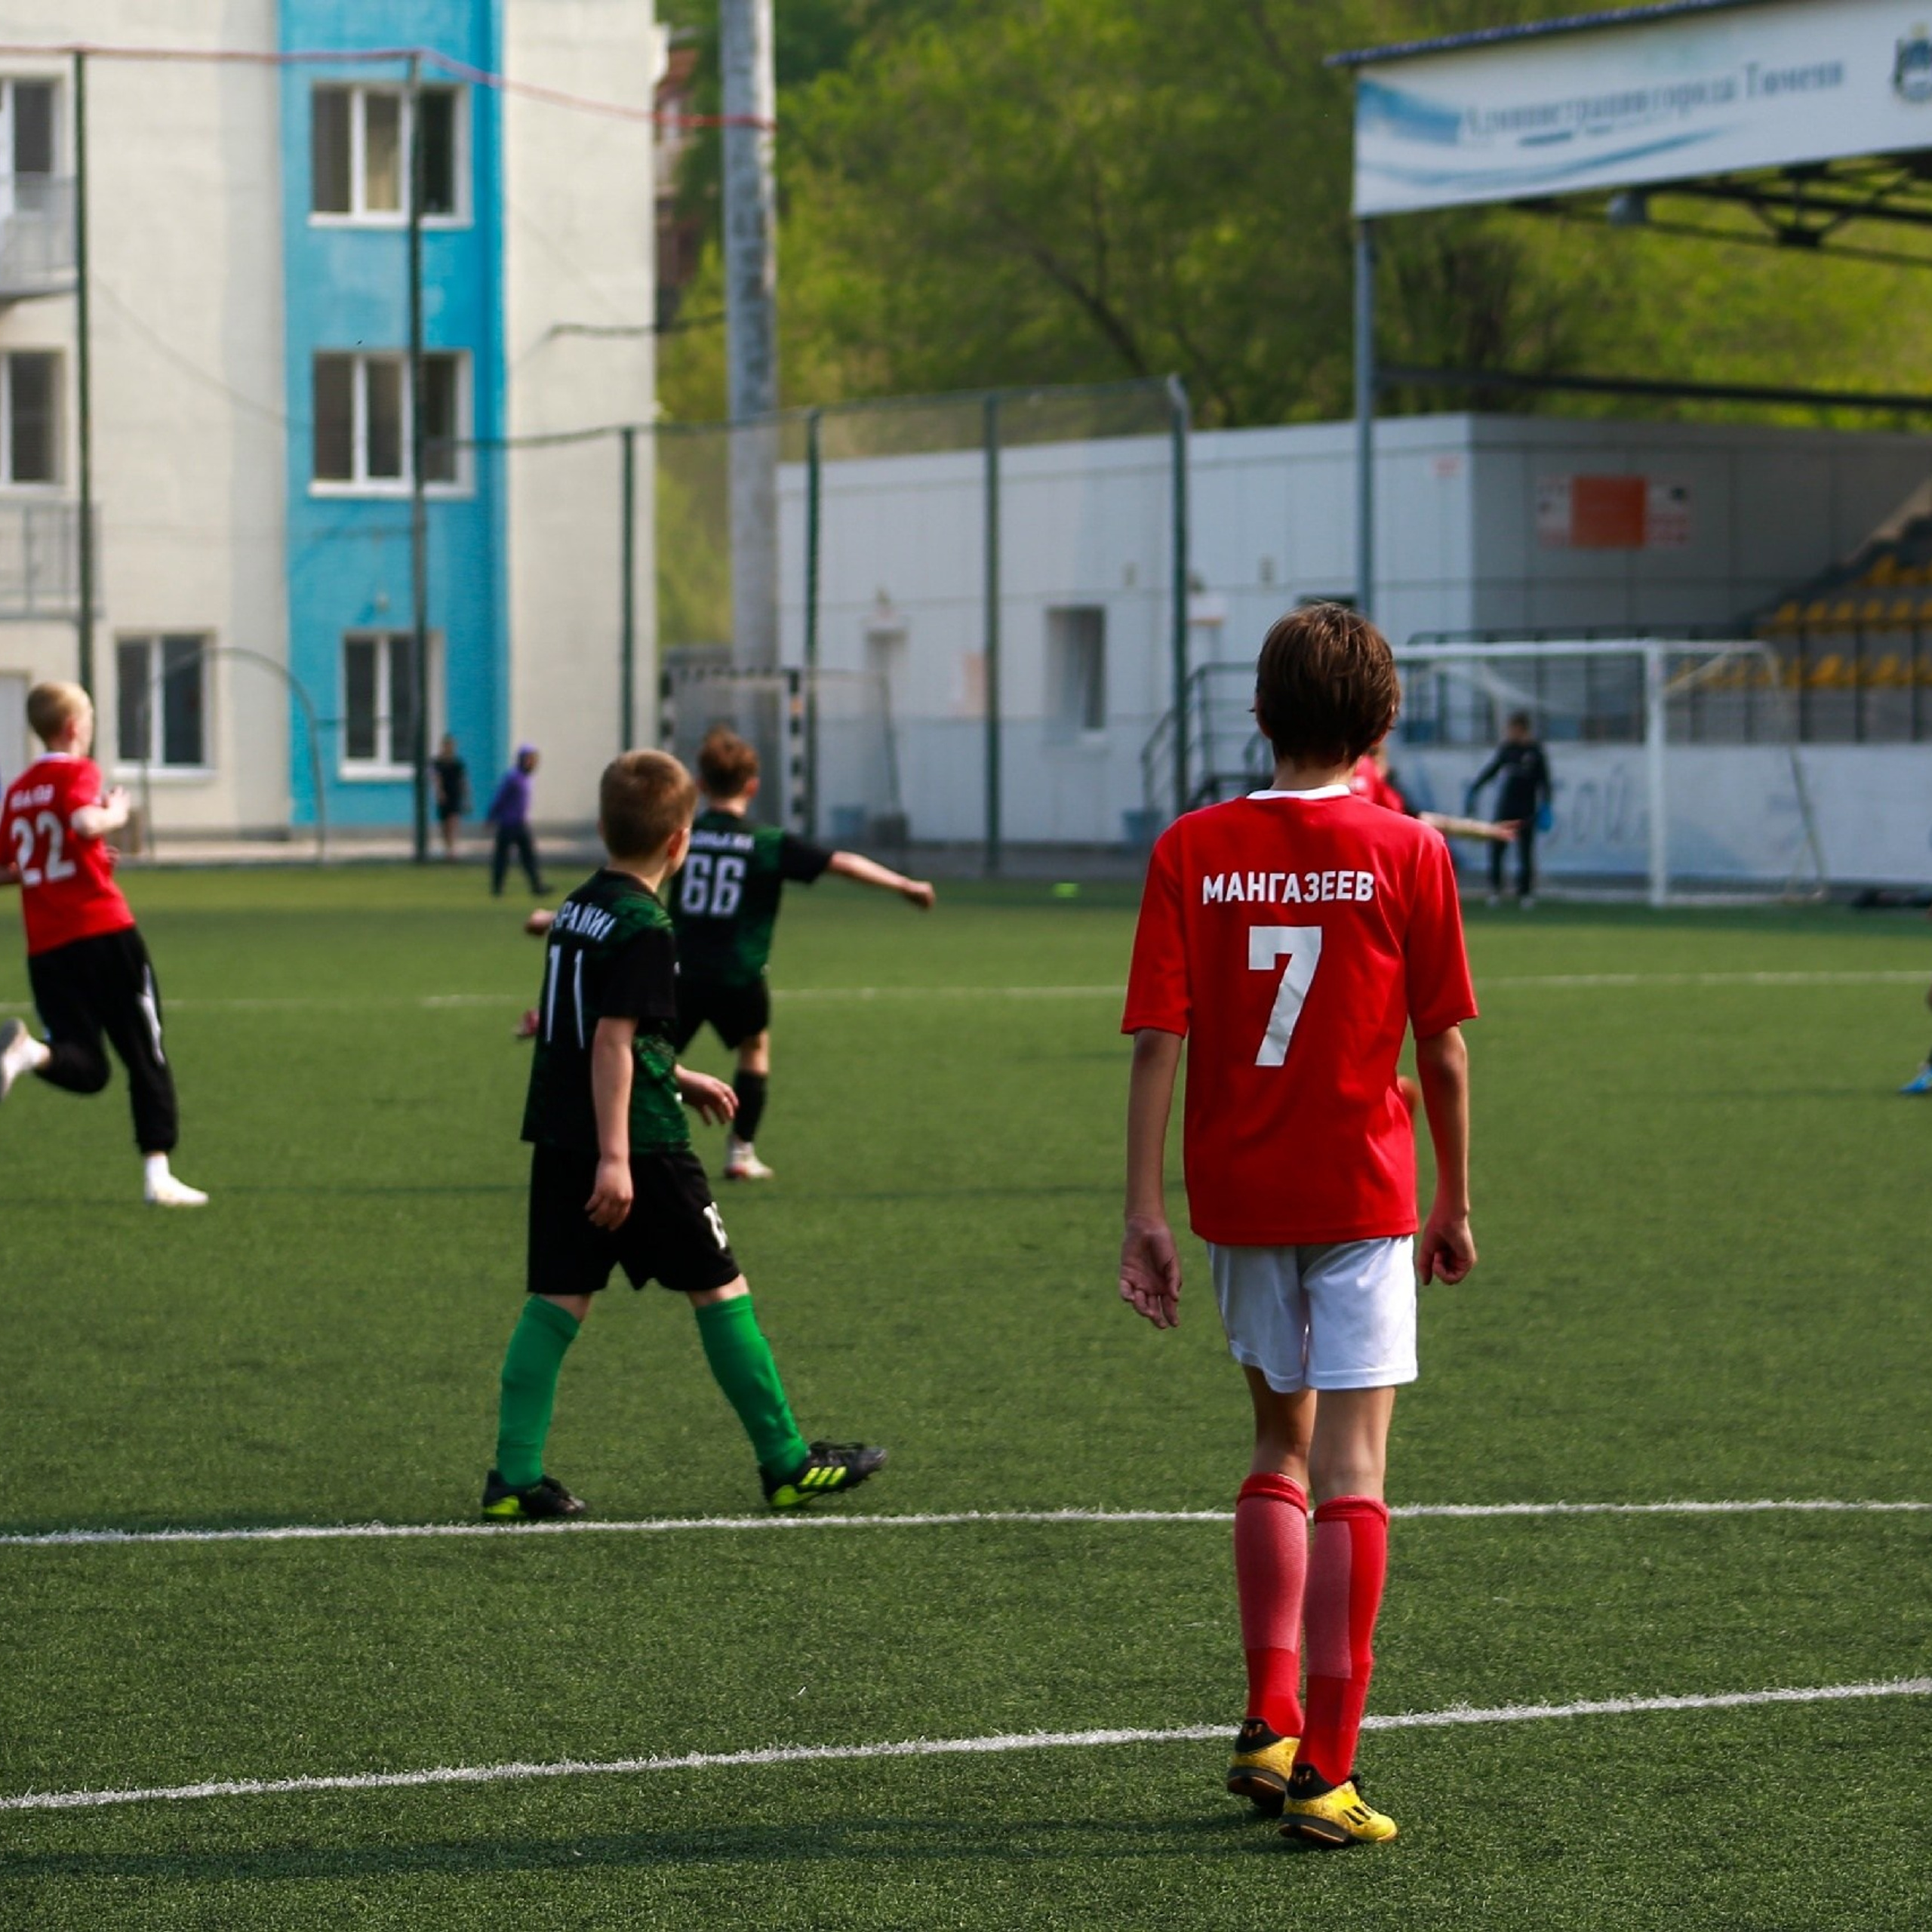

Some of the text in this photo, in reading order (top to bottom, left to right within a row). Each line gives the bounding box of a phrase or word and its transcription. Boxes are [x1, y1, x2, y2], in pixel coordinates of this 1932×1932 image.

[11, 811, 76, 887] 22
[681, 853, 746, 915] 66
[1202, 870, 1374, 905] МАНГАЗЕЕВ
[546, 945, 585, 1049] 11
[1248, 925, 1322, 1066] 7
